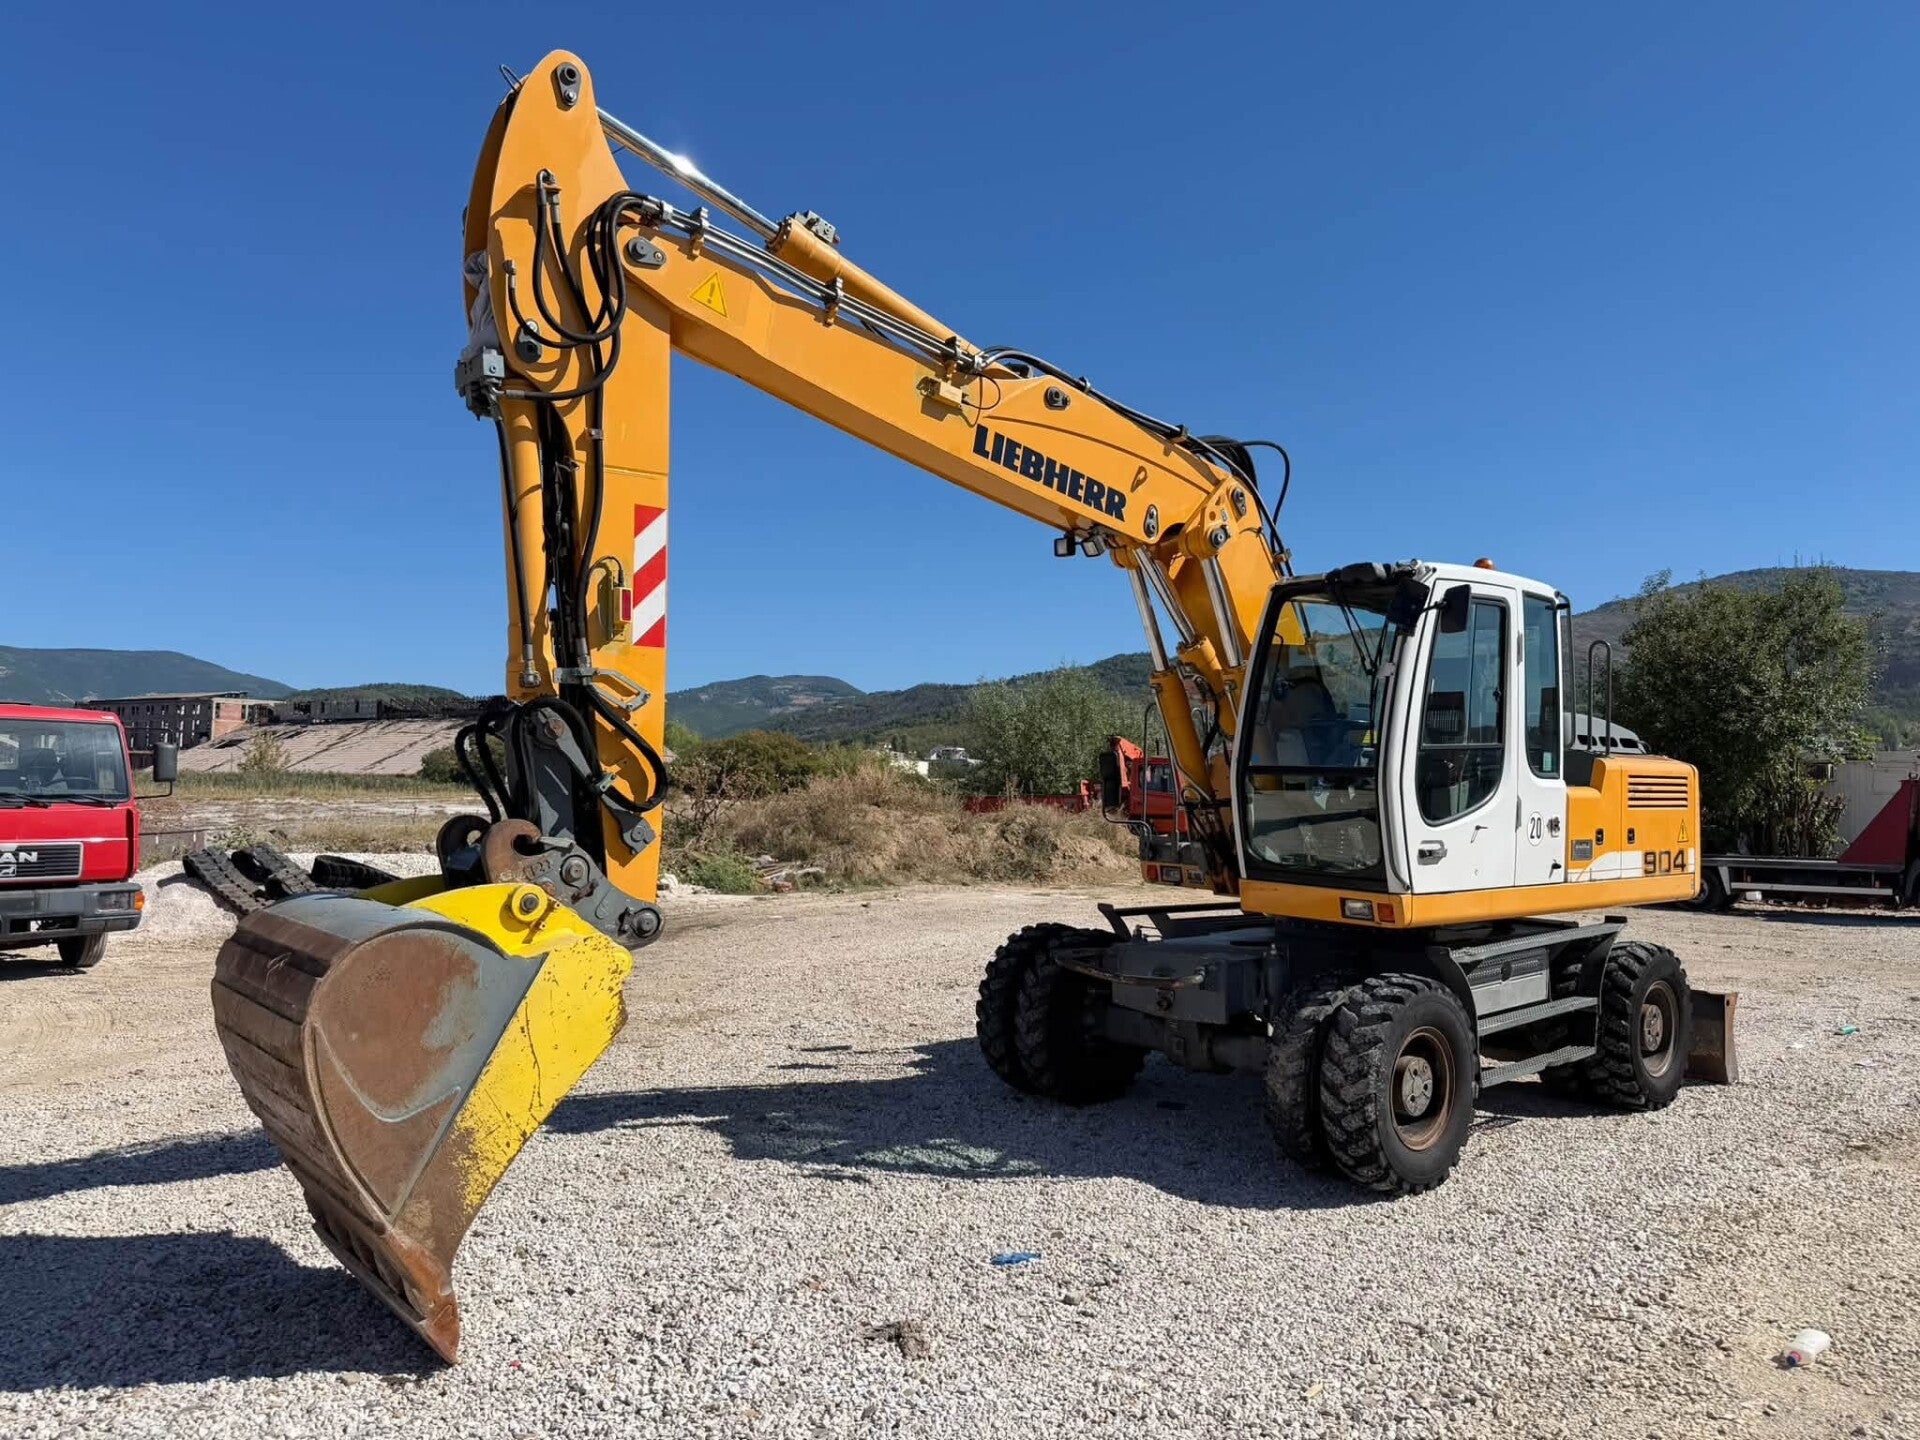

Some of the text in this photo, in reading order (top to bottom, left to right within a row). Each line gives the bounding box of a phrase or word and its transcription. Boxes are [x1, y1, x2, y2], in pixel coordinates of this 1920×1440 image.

[973, 423, 1127, 522] LIEBHERR
[1530, 817, 1542, 839] 20
[1644, 849, 1686, 875] 904
